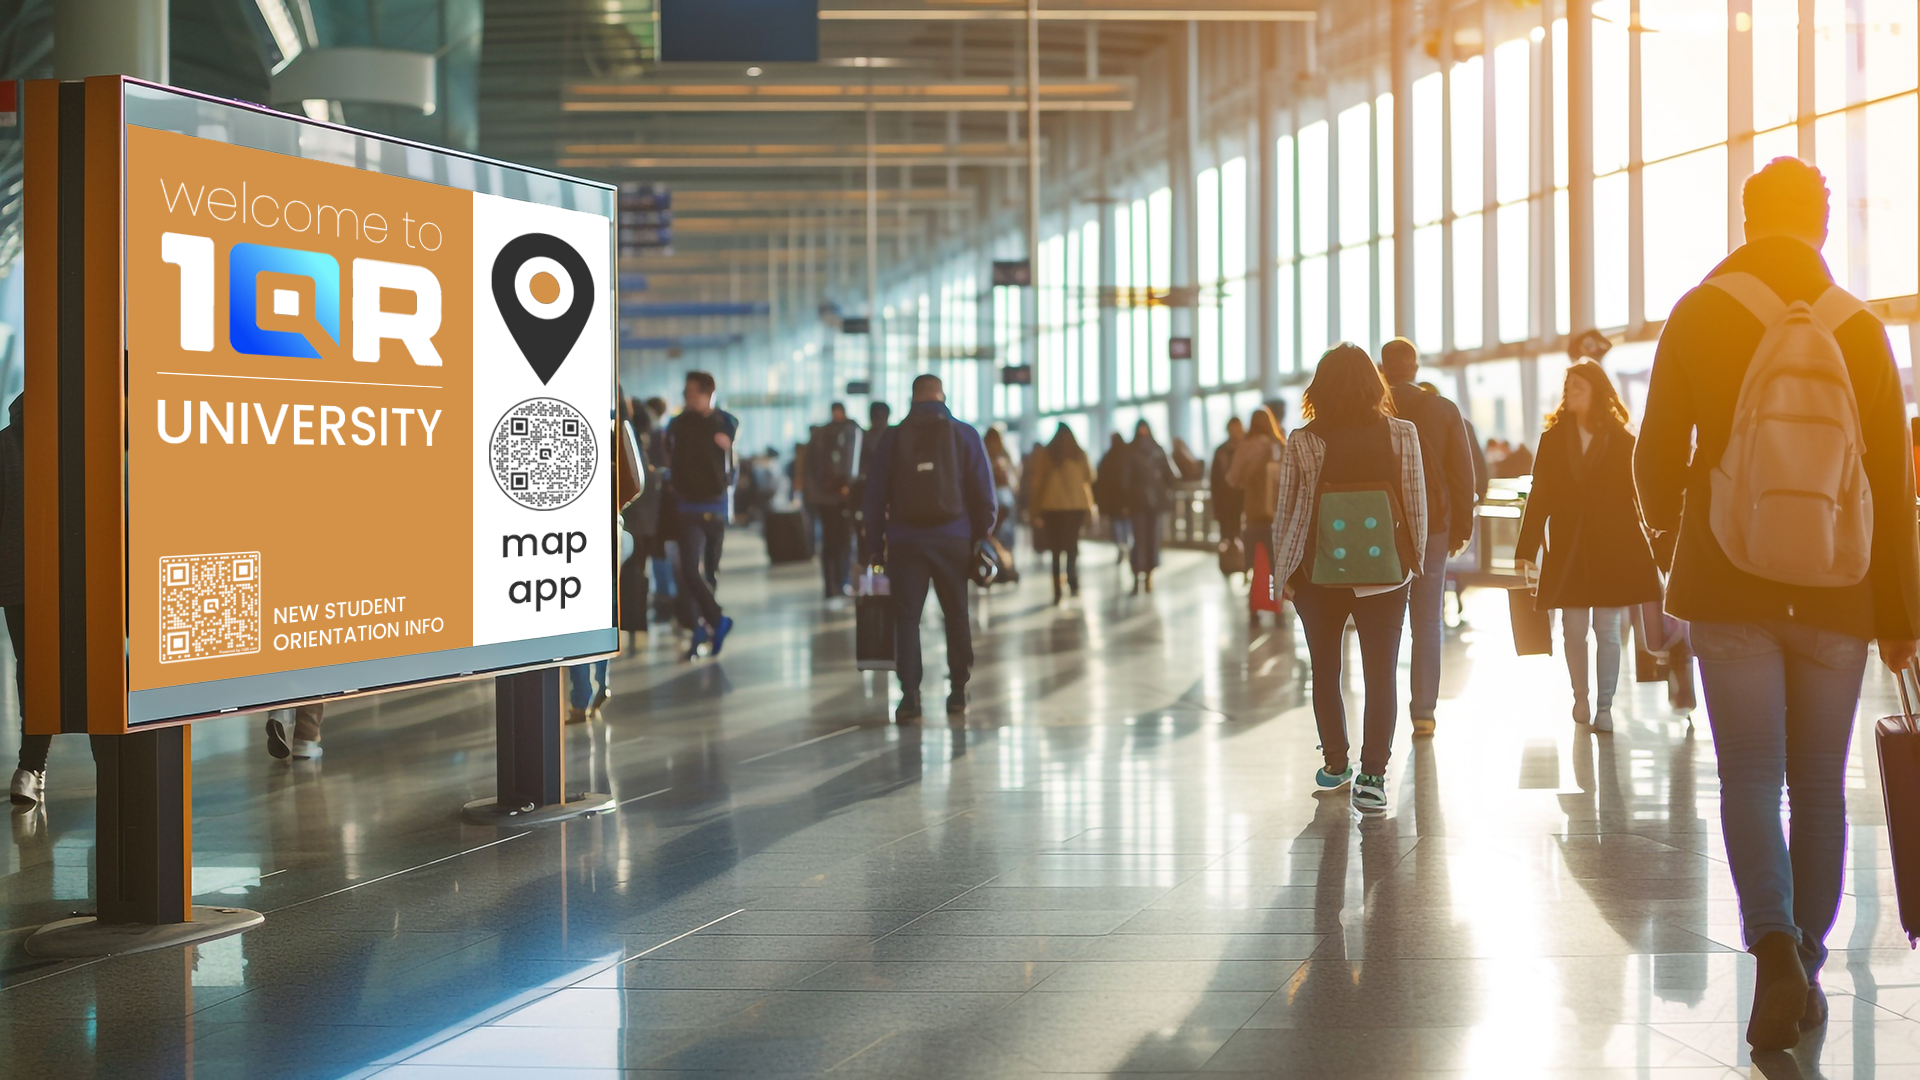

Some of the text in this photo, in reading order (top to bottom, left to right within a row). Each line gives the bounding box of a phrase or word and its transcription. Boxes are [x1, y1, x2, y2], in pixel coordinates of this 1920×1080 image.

[160, 178, 442, 251] welcome to
[161, 231, 443, 367] 1QR
[157, 399, 443, 447] UNIVERSITY
[502, 531, 587, 564] map
[273, 596, 406, 625] NEW STUDENT
[508, 576, 582, 612] app
[273, 616, 445, 651] ORIENTATION INFO
